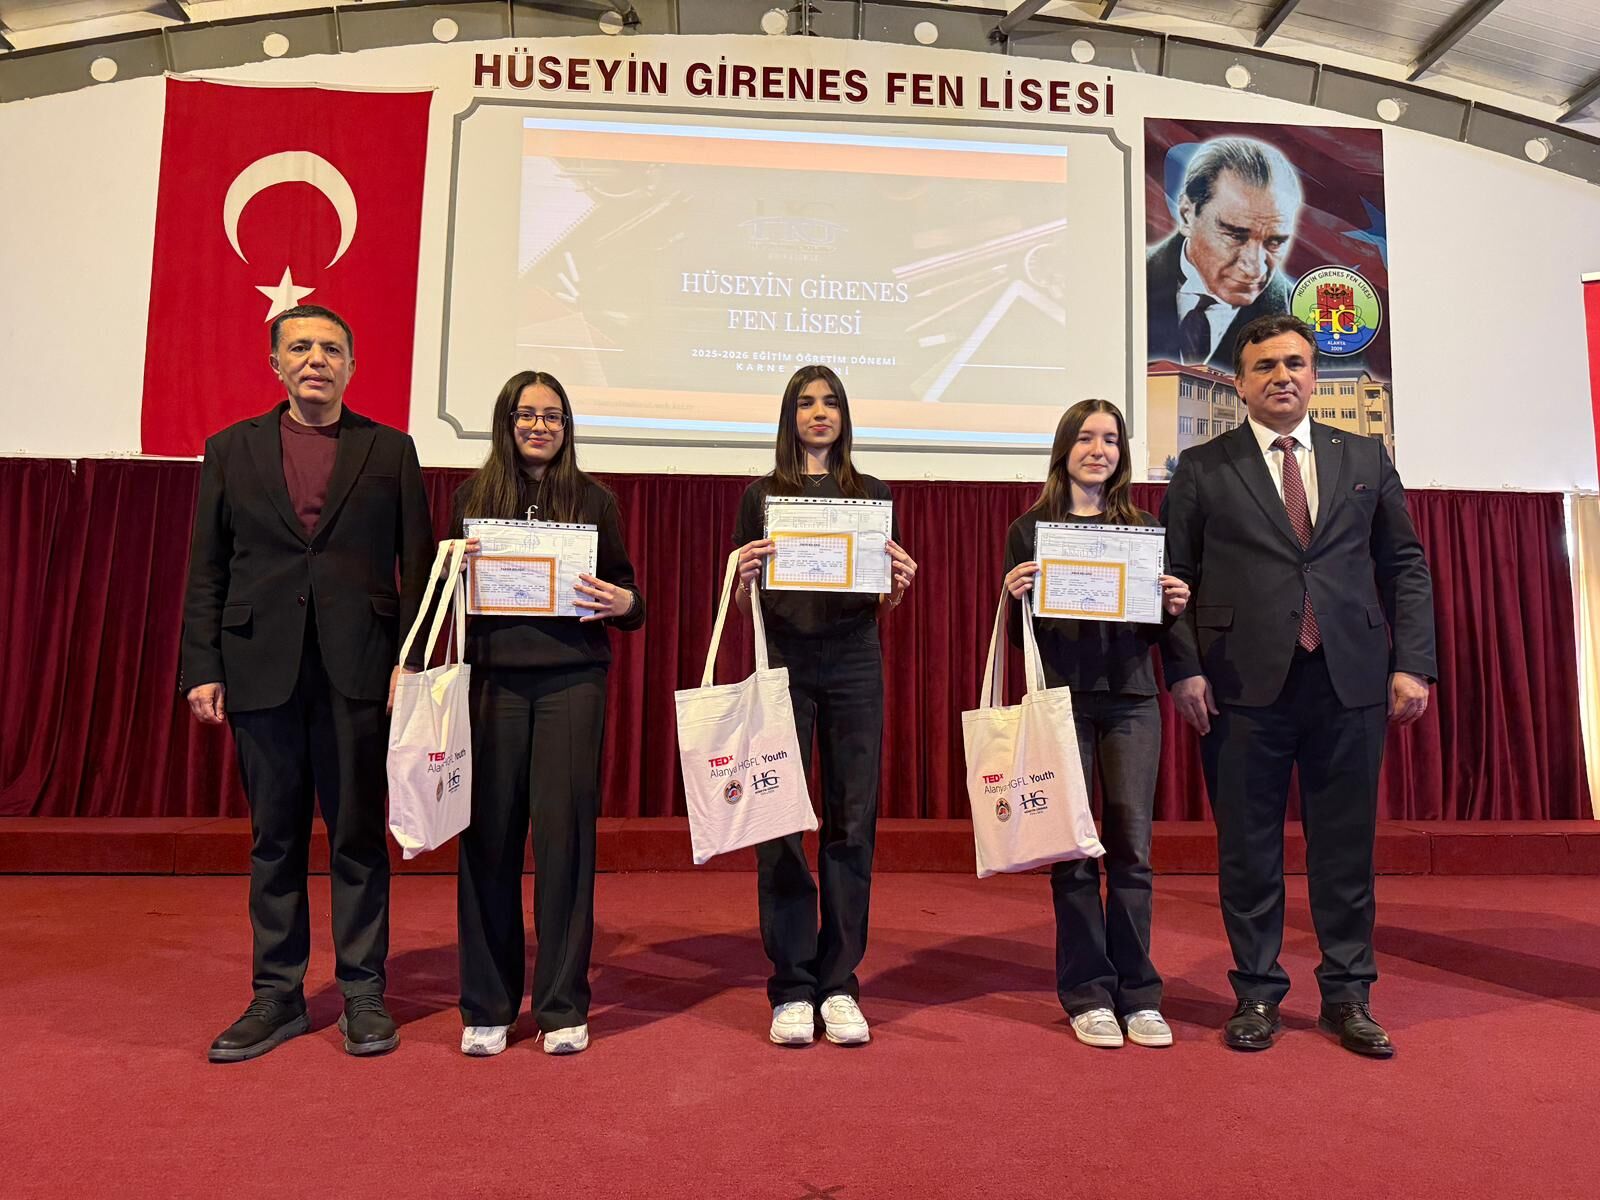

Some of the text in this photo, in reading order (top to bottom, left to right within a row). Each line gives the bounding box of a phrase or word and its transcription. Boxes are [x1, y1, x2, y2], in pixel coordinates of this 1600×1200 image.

[474, 47, 1115, 118] HÜSEYİN GİRENES FEN LİSESİ
[680, 269, 909, 303] HÜSEYİN GİRENES
[727, 307, 862, 335] FEN LİSESİ
[692, 349, 897, 366] 2025-2026 EĞİTİM ÖĞRETİM DÖNEMİ
[735, 363, 785, 373] KARNE
[761, 750, 788, 763] Youth
[1029, 770, 1055, 784] Youth
